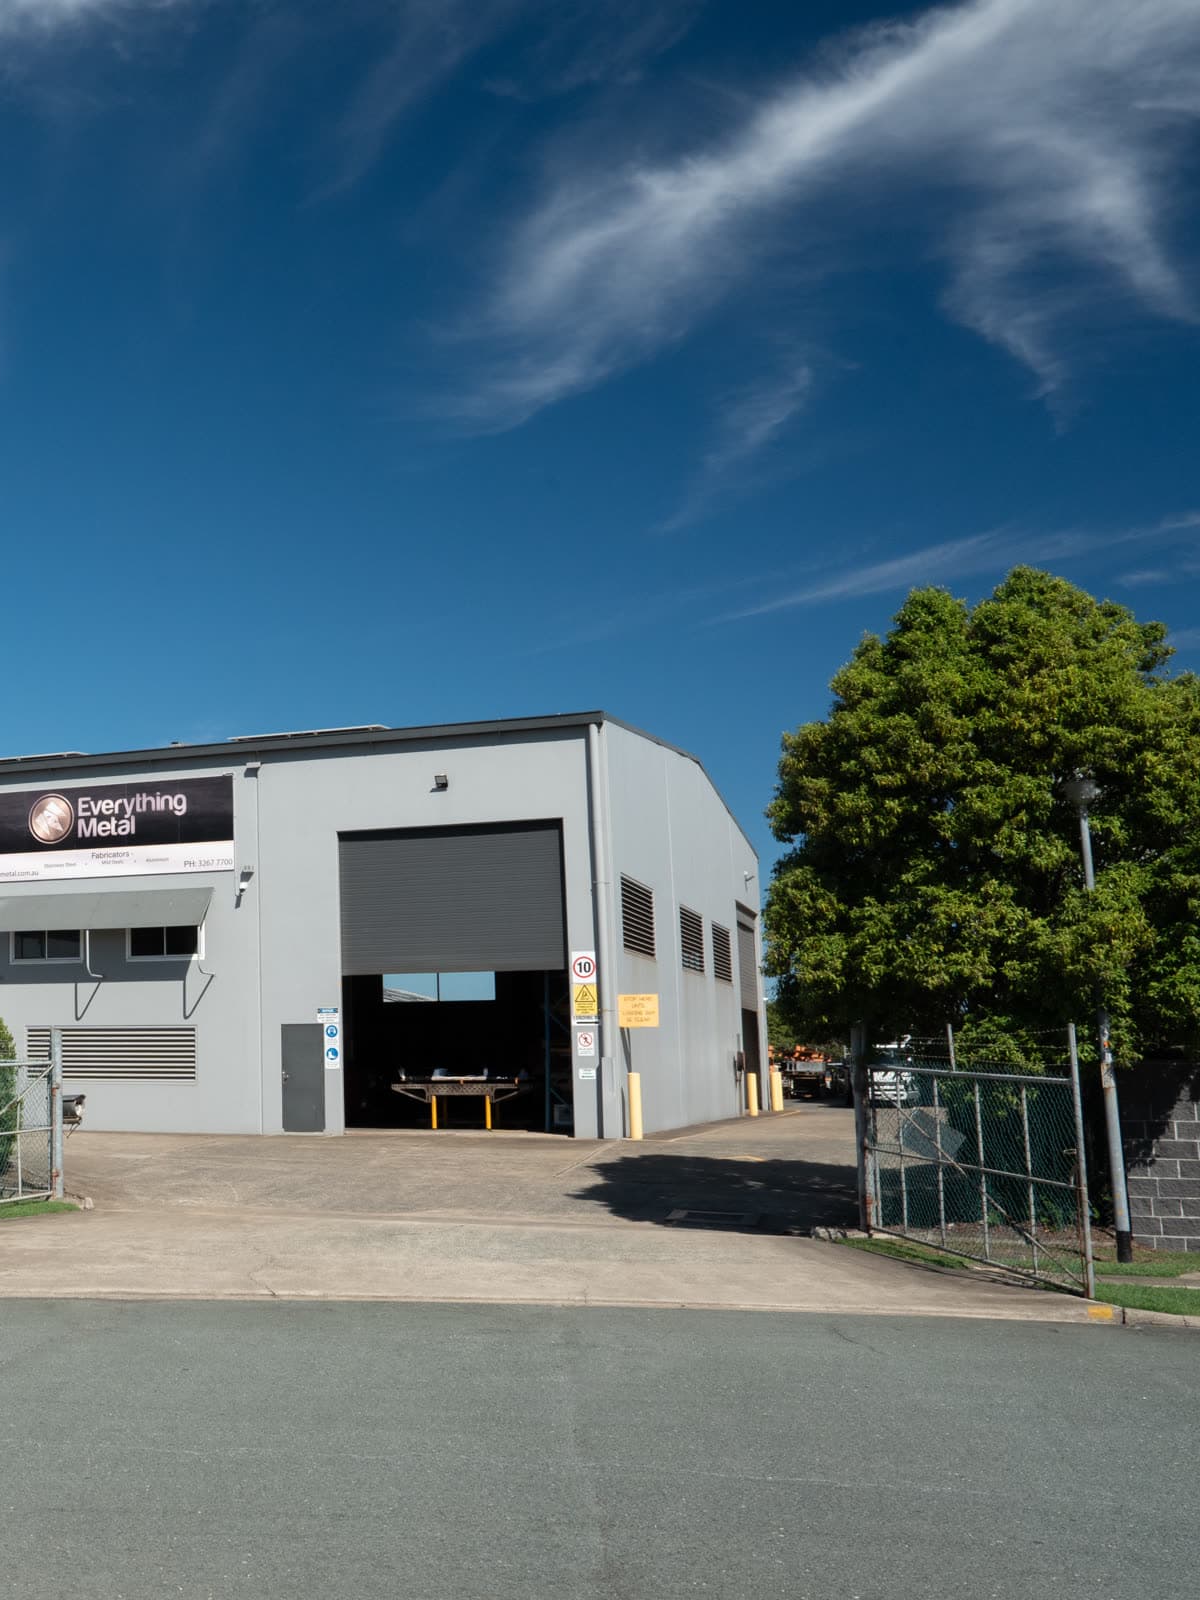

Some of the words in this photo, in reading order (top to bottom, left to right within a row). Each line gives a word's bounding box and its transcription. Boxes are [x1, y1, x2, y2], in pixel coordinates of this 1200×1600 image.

[78, 792, 187, 819] Everything
[78, 815, 135, 838] Metal
[91, 850, 130, 860] Fabricators
[184, 860, 196, 868] PH:
[577, 961, 591, 973] 10
